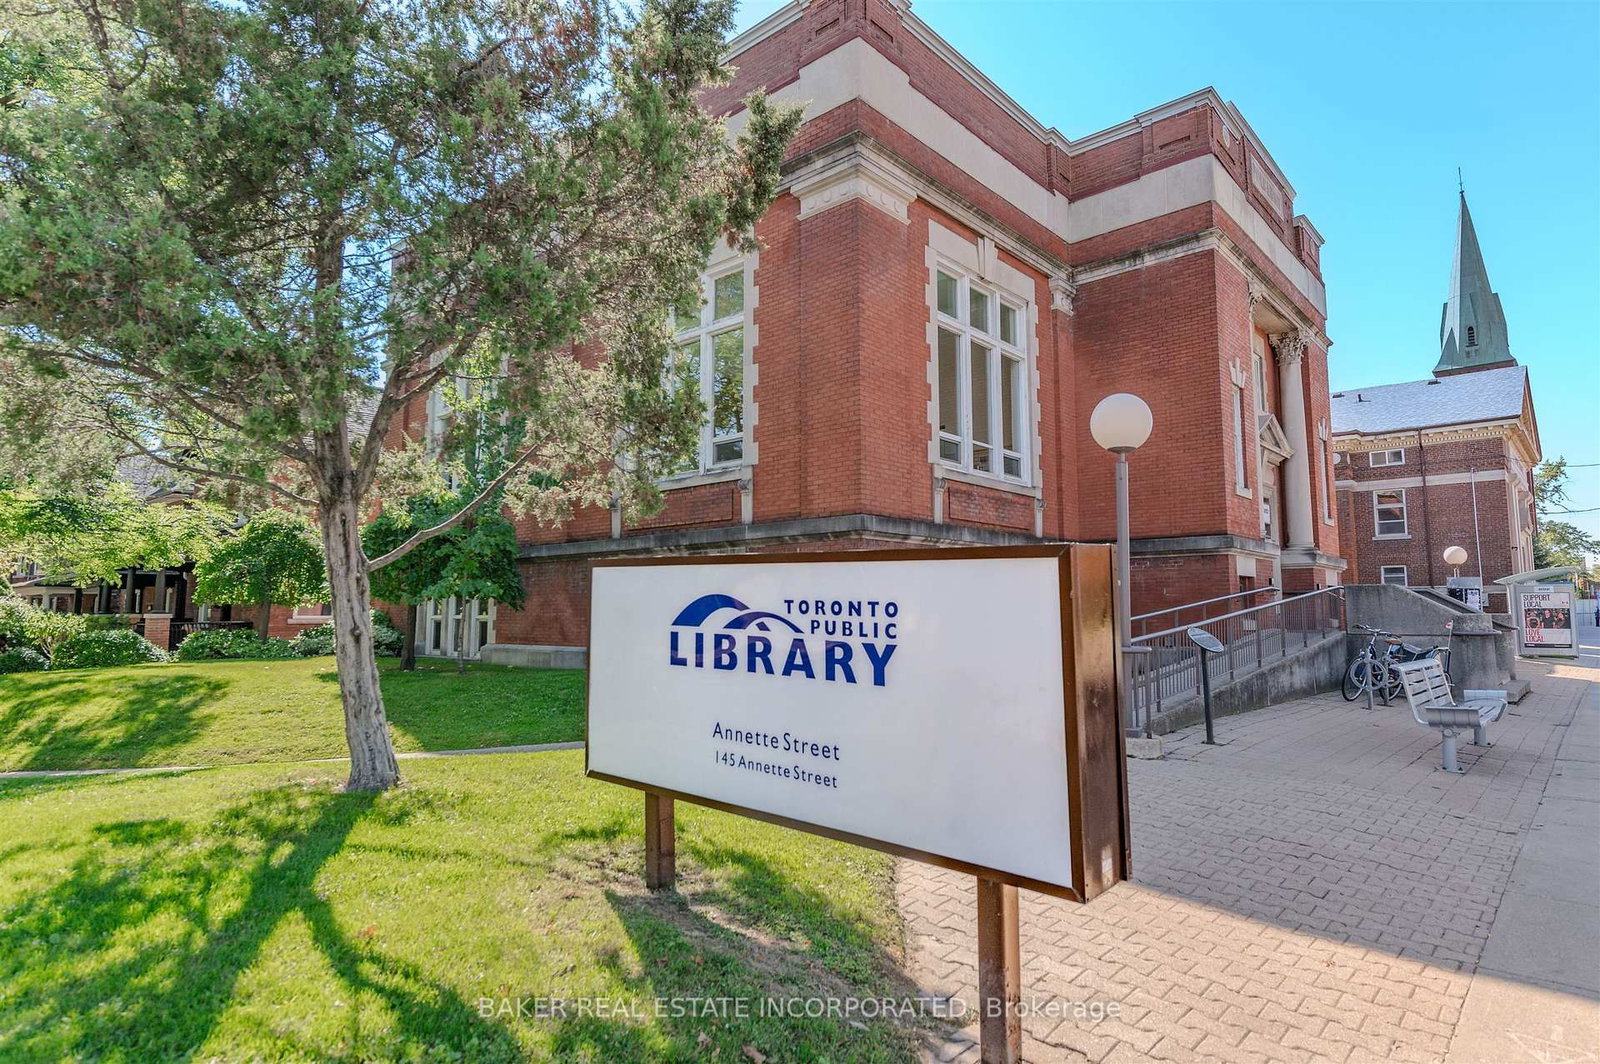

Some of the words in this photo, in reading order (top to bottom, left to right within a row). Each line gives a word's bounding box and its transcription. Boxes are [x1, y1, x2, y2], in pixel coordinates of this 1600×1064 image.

[784, 600, 899, 618] TORONTO
[810, 619, 898, 639] PUBLIC
[669, 631, 898, 687] LIBRARY
[712, 721, 779, 749] Annette
[783, 732, 840, 761] Street
[715, 750, 735, 767] 145
[738, 755, 791, 778] Annette
[793, 765, 838, 789] Street
